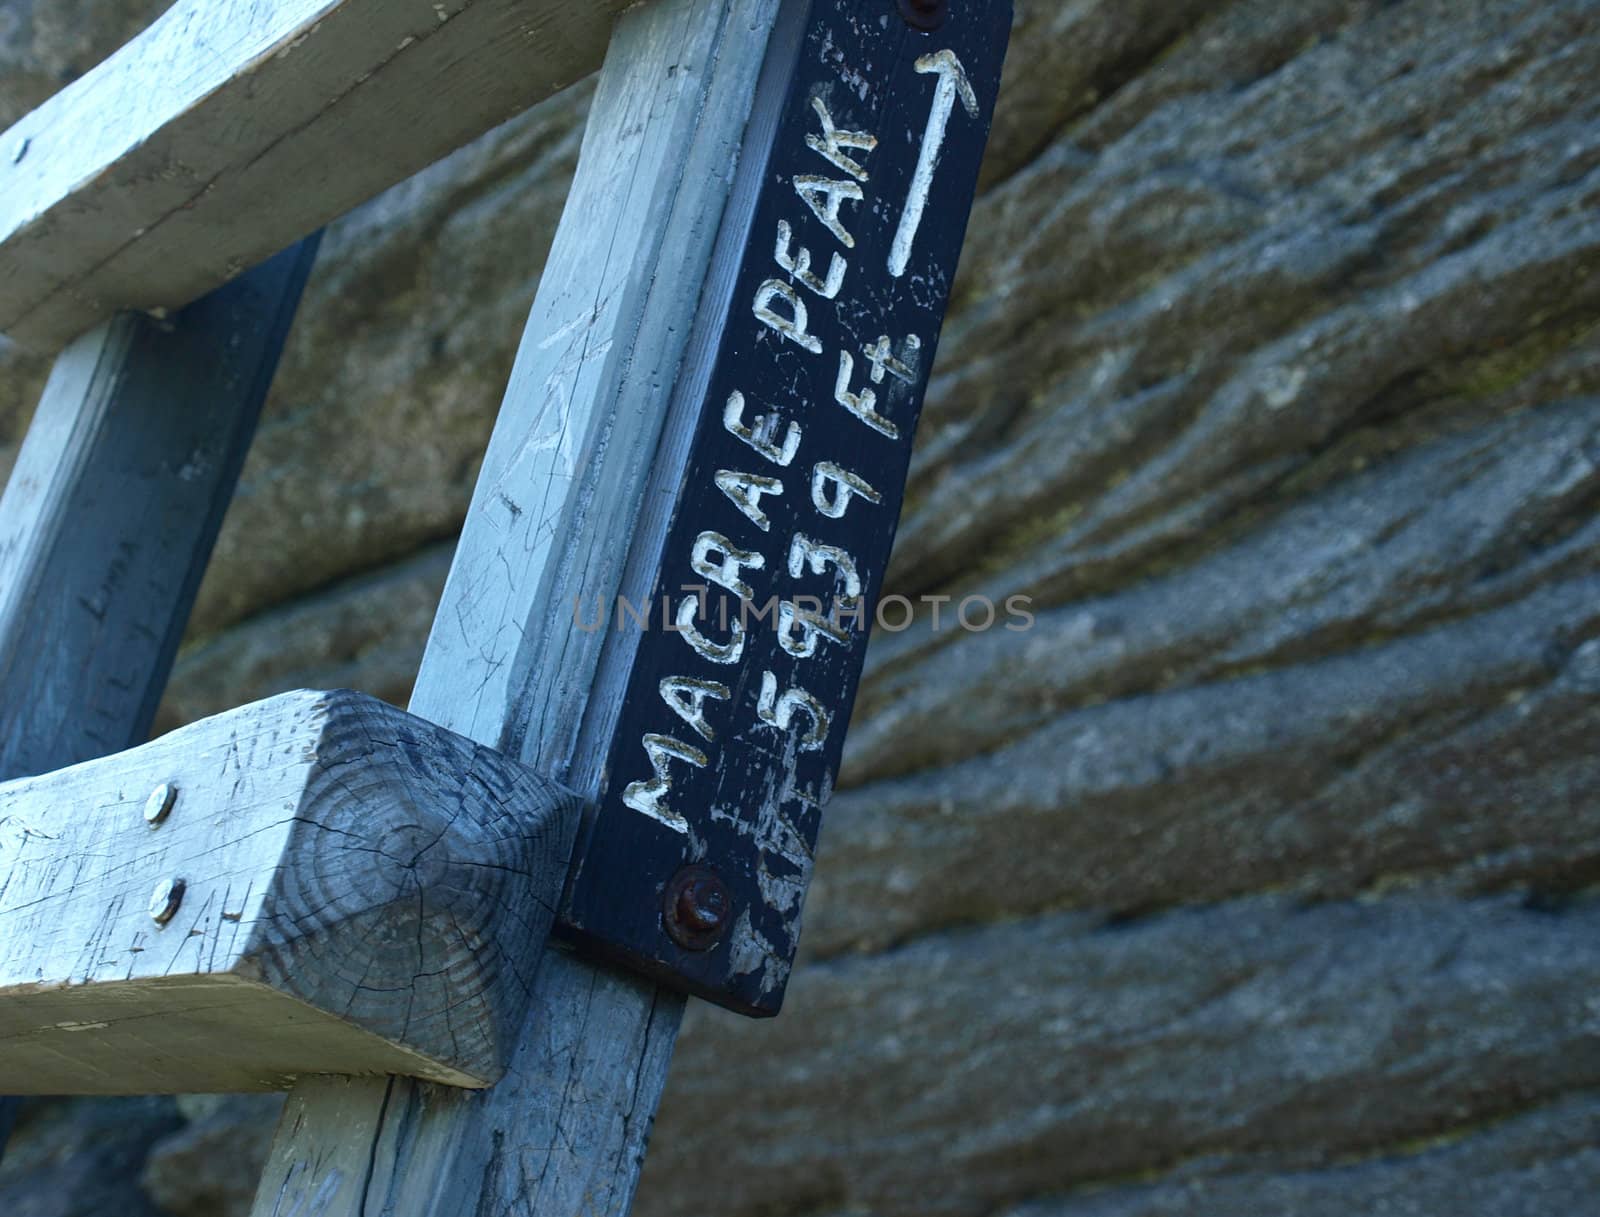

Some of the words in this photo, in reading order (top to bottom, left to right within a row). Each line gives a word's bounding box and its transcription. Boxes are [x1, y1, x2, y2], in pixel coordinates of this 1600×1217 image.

[622, 389, 802, 834] MACRAE
[753, 96, 878, 354] PEAK
[756, 460, 883, 751] 5939
